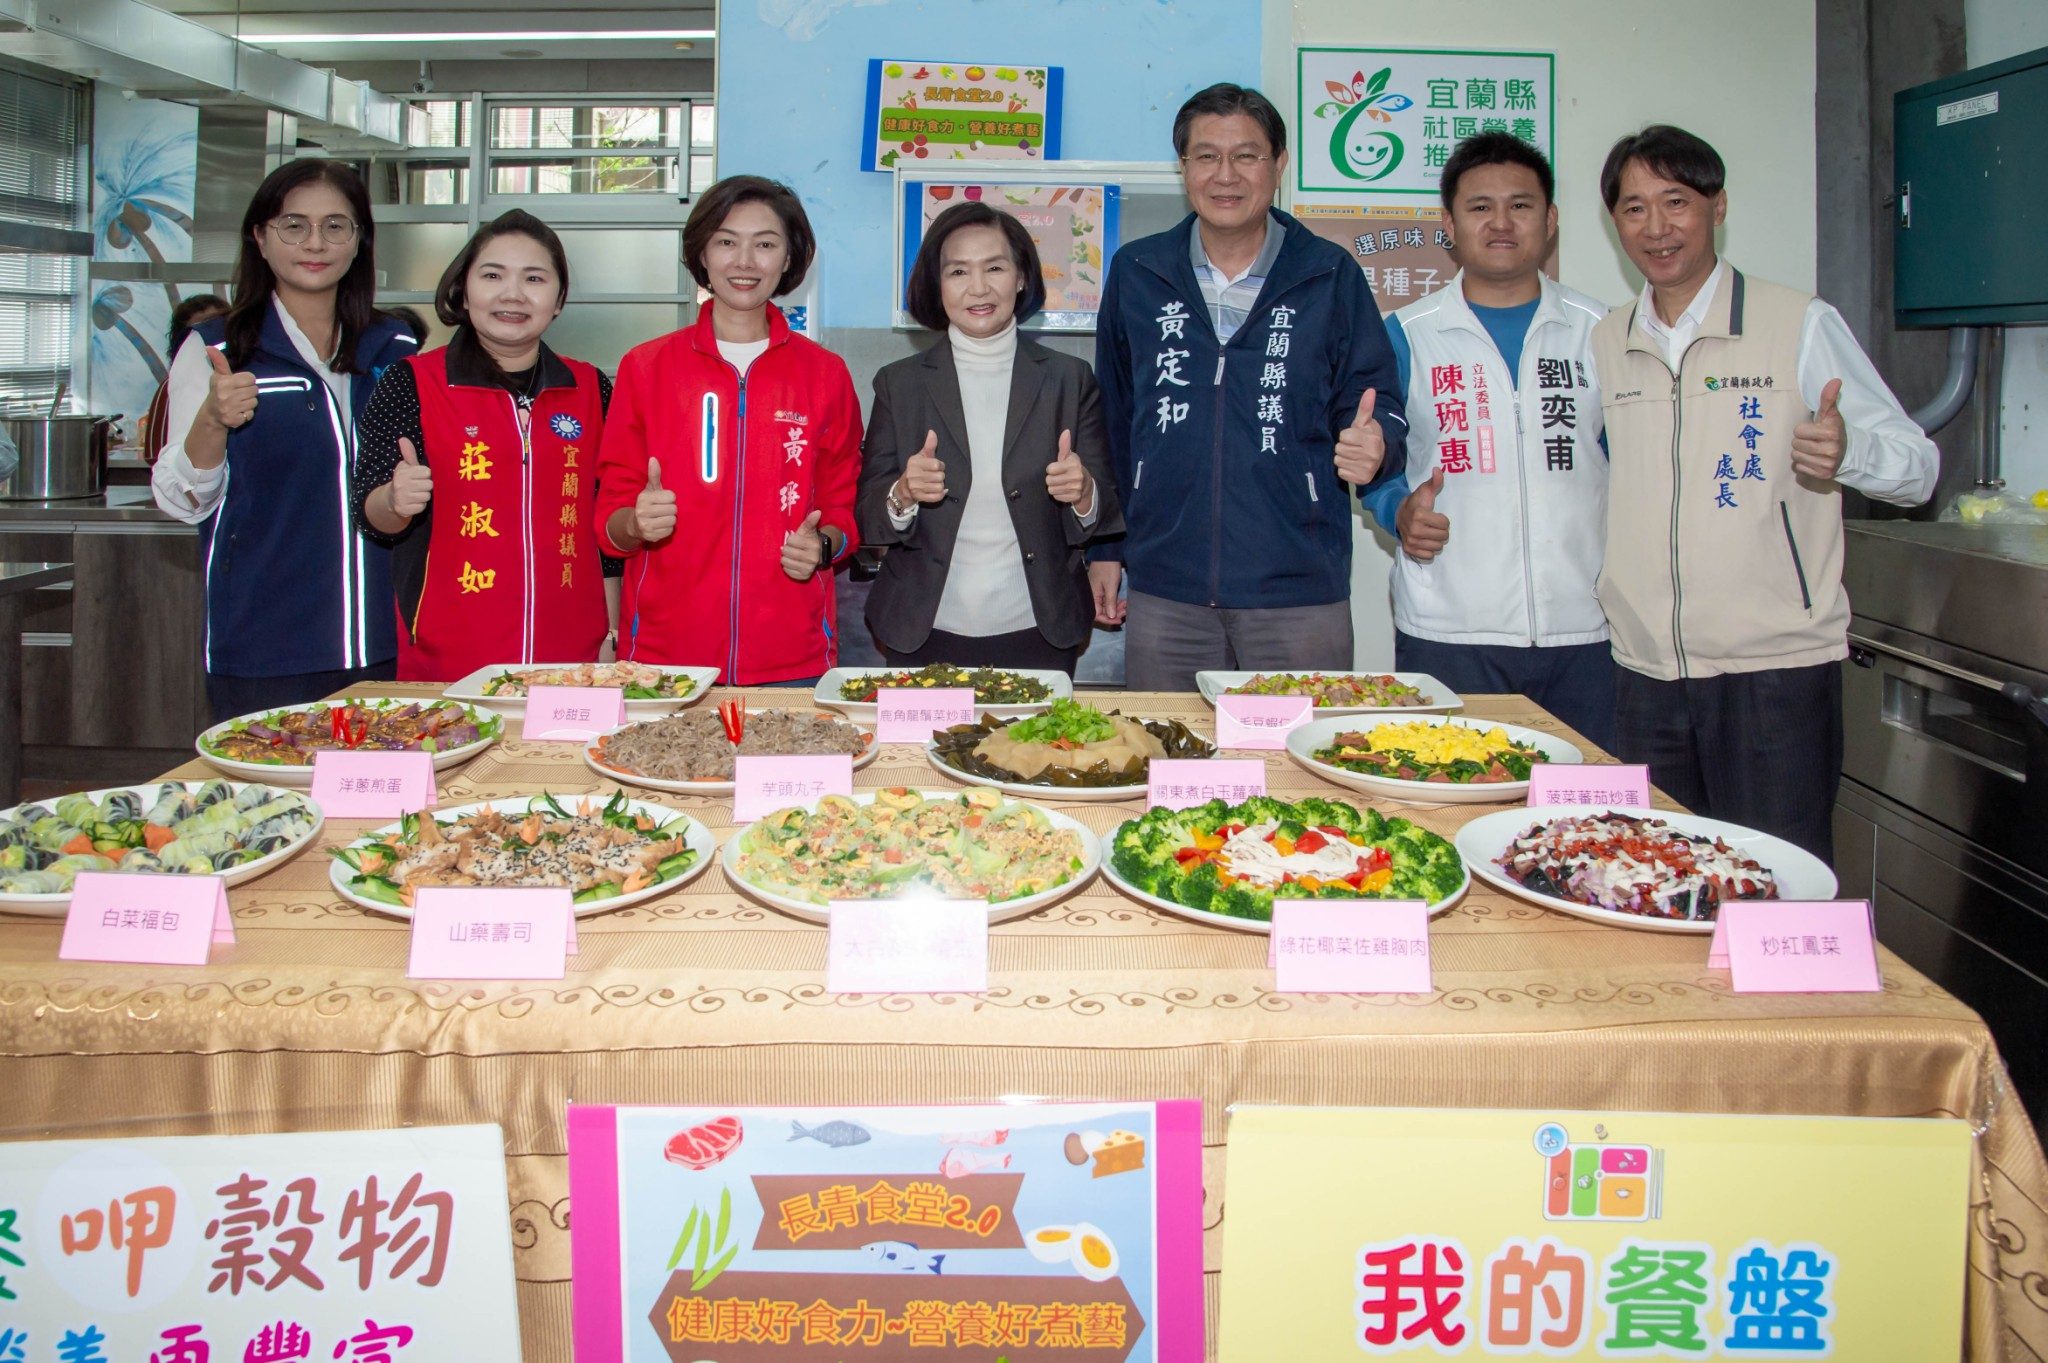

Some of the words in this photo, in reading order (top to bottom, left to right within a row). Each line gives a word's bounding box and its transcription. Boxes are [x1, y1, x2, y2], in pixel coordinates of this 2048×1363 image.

[1426, 78, 1536, 110] 宜蘭縣
[1423, 116, 1536, 142] 社區營養
[1156, 300, 1191, 434] 黃定和
[1257, 305, 1296, 455] 宜蘭縣議員
[1472, 363, 1491, 420] 立法委員
[1721, 376, 1774, 389] 宜蘭縣政府
[1431, 364, 1473, 474] 陳琬惠
[1537, 358, 1576, 471] 劉奕甫
[457, 441, 500, 594] 莊淑如
[559, 445, 581, 589] 宜蘭縣議員
[553, 708, 592, 722] 炒甜豆
[338, 778, 402, 793] 洋蔥煎蛋
[762, 781, 825, 797] 芋頭丸子
[1546, 790, 1640, 805] 菠菜蕃茄炒蛋
[102, 908, 180, 931] 白菜福包
[449, 922, 532, 943] 山藥壽司
[1279, 936, 1427, 956] 綠花椰菜佐雞胸肉
[1760, 935, 1841, 956] 炒紅鳳菜
[779, 1180, 1001, 1242] 長青食堂2.0
[1362, 1243, 1830, 1351] 我的餐盤
